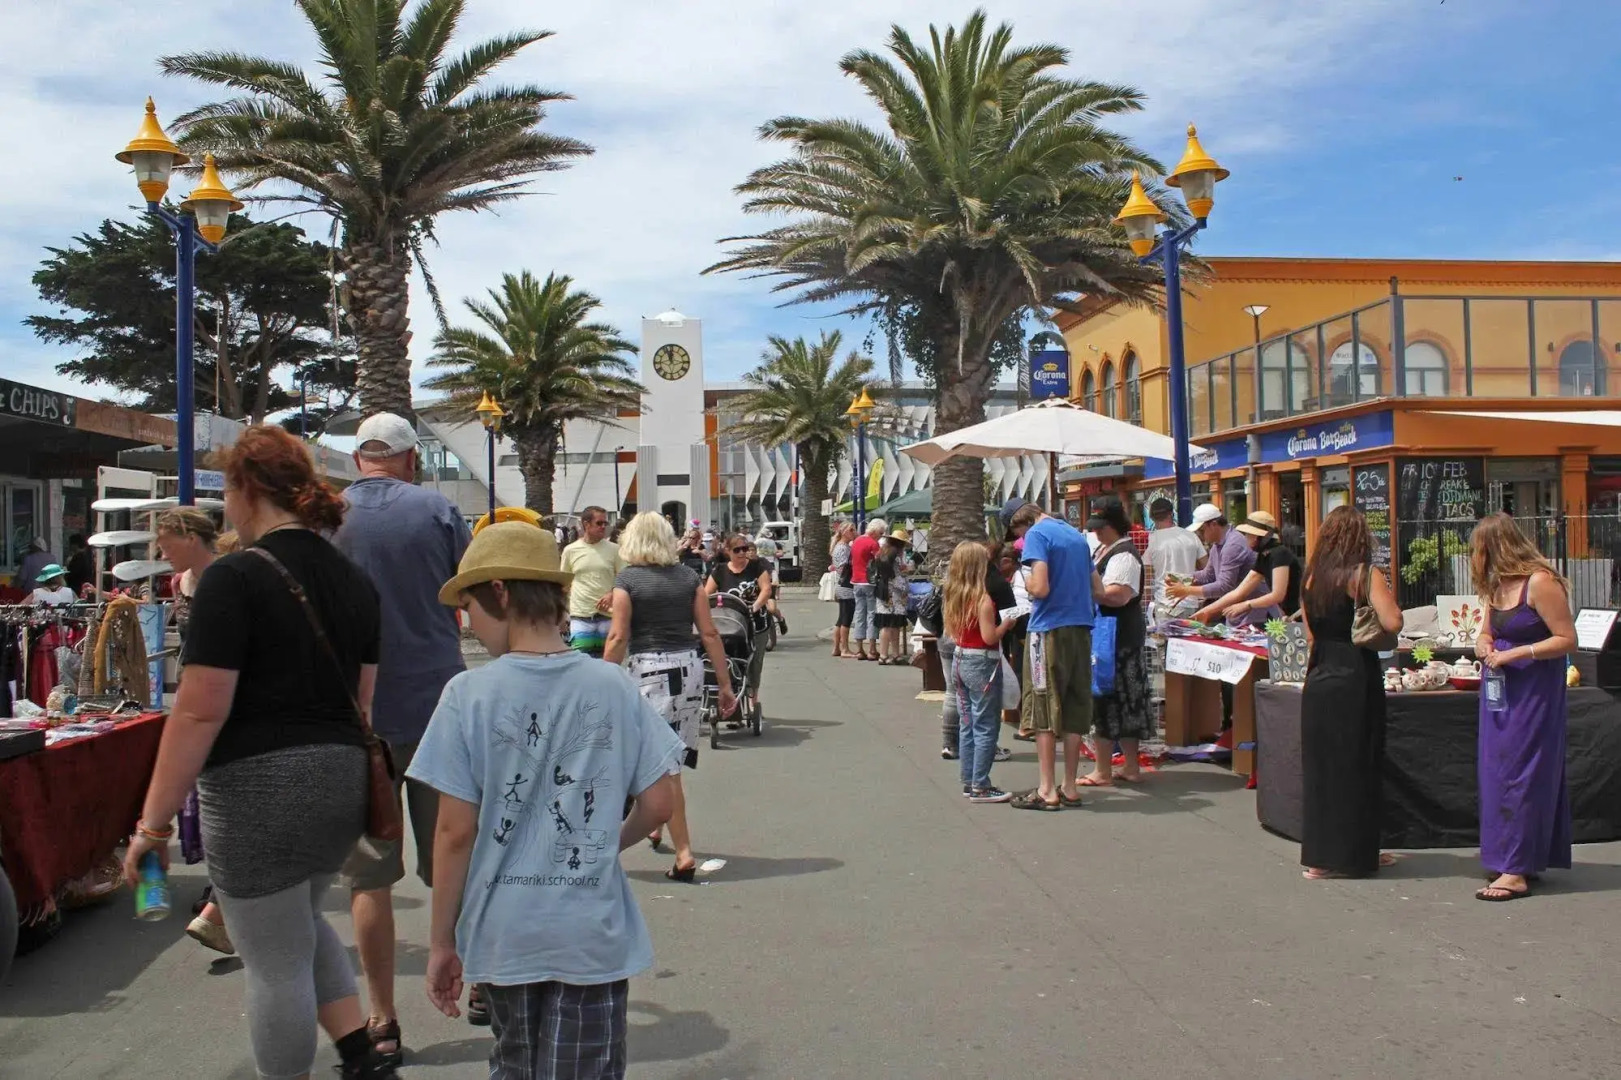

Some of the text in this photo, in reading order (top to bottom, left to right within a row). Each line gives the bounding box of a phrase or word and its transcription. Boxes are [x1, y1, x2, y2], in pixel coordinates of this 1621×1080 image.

[1033, 370, 1066, 381] Corona
[10, 387, 60, 419] CHIPS
[1287, 436, 1318, 458] Corona
